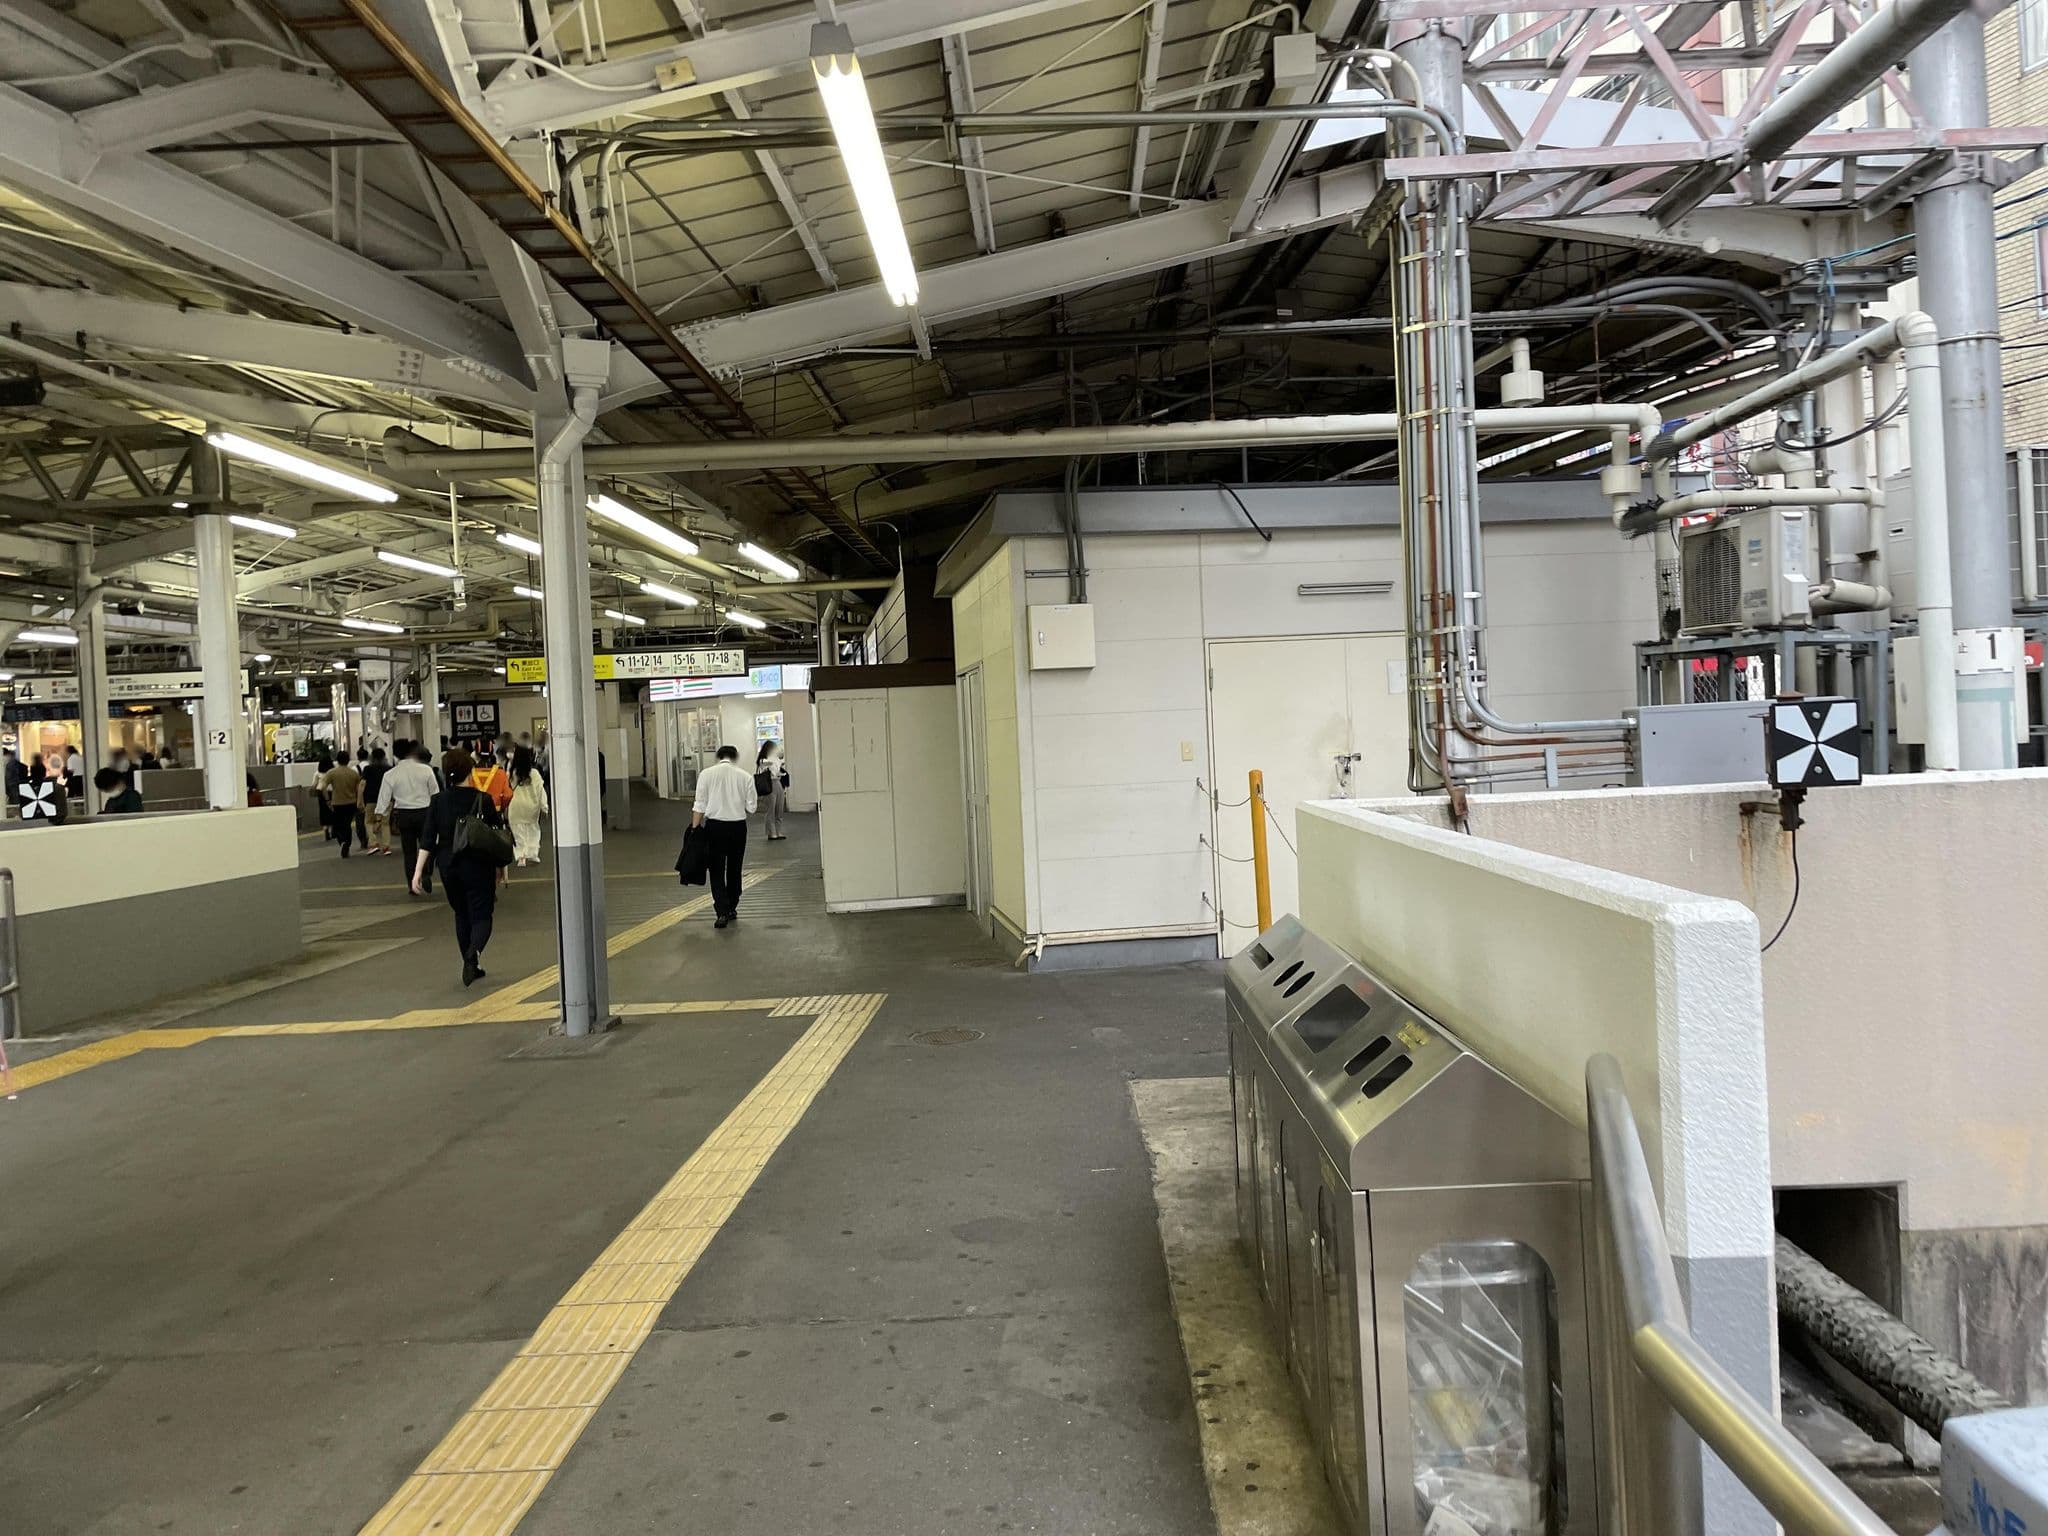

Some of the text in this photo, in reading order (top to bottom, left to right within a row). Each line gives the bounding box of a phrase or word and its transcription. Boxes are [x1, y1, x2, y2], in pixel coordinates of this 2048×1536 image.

[1986, 633, 1997, 660] 1
[653, 654, 662, 666] 14
[20, 682, 35, 700] 4
